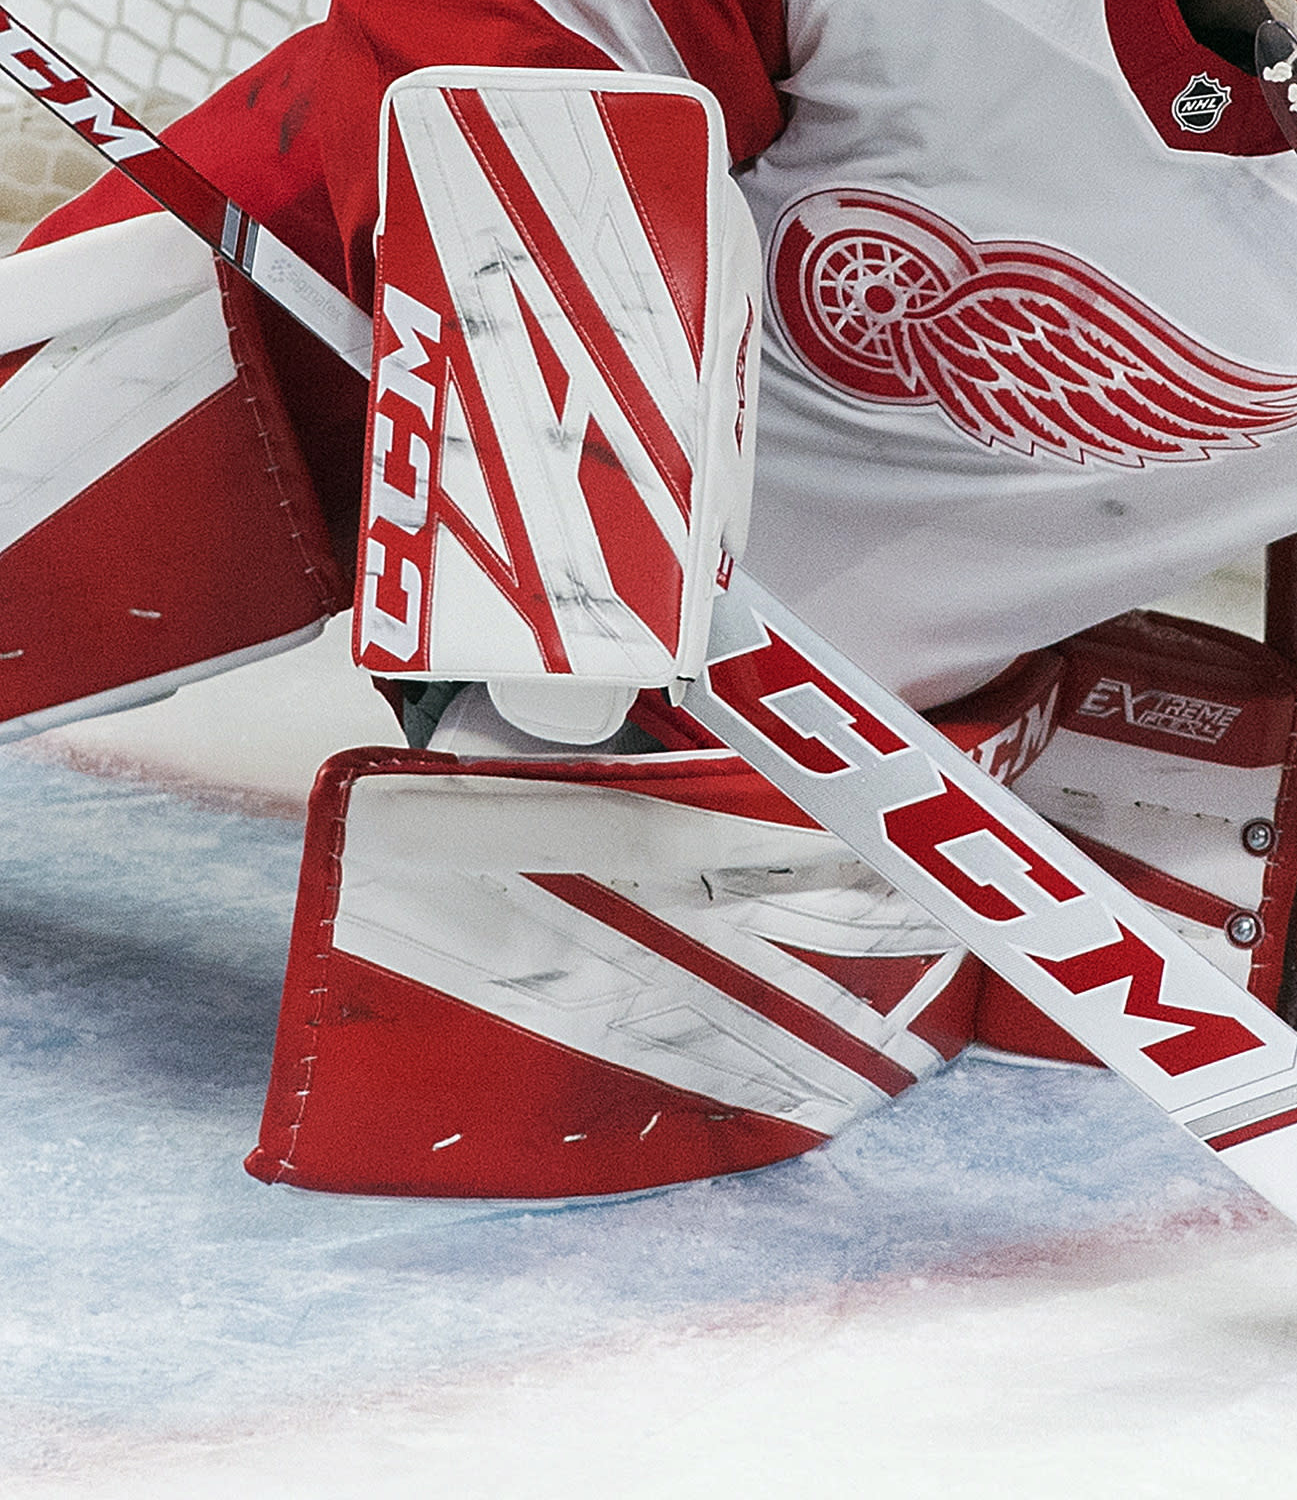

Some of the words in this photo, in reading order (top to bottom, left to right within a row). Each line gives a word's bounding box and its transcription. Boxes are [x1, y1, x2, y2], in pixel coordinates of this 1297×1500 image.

[1180, 97, 1217, 113] NHL
[359, 283, 442, 663] CCM
[704, 618, 1268, 1078] CCM
[962, 681, 1060, 786] CM
